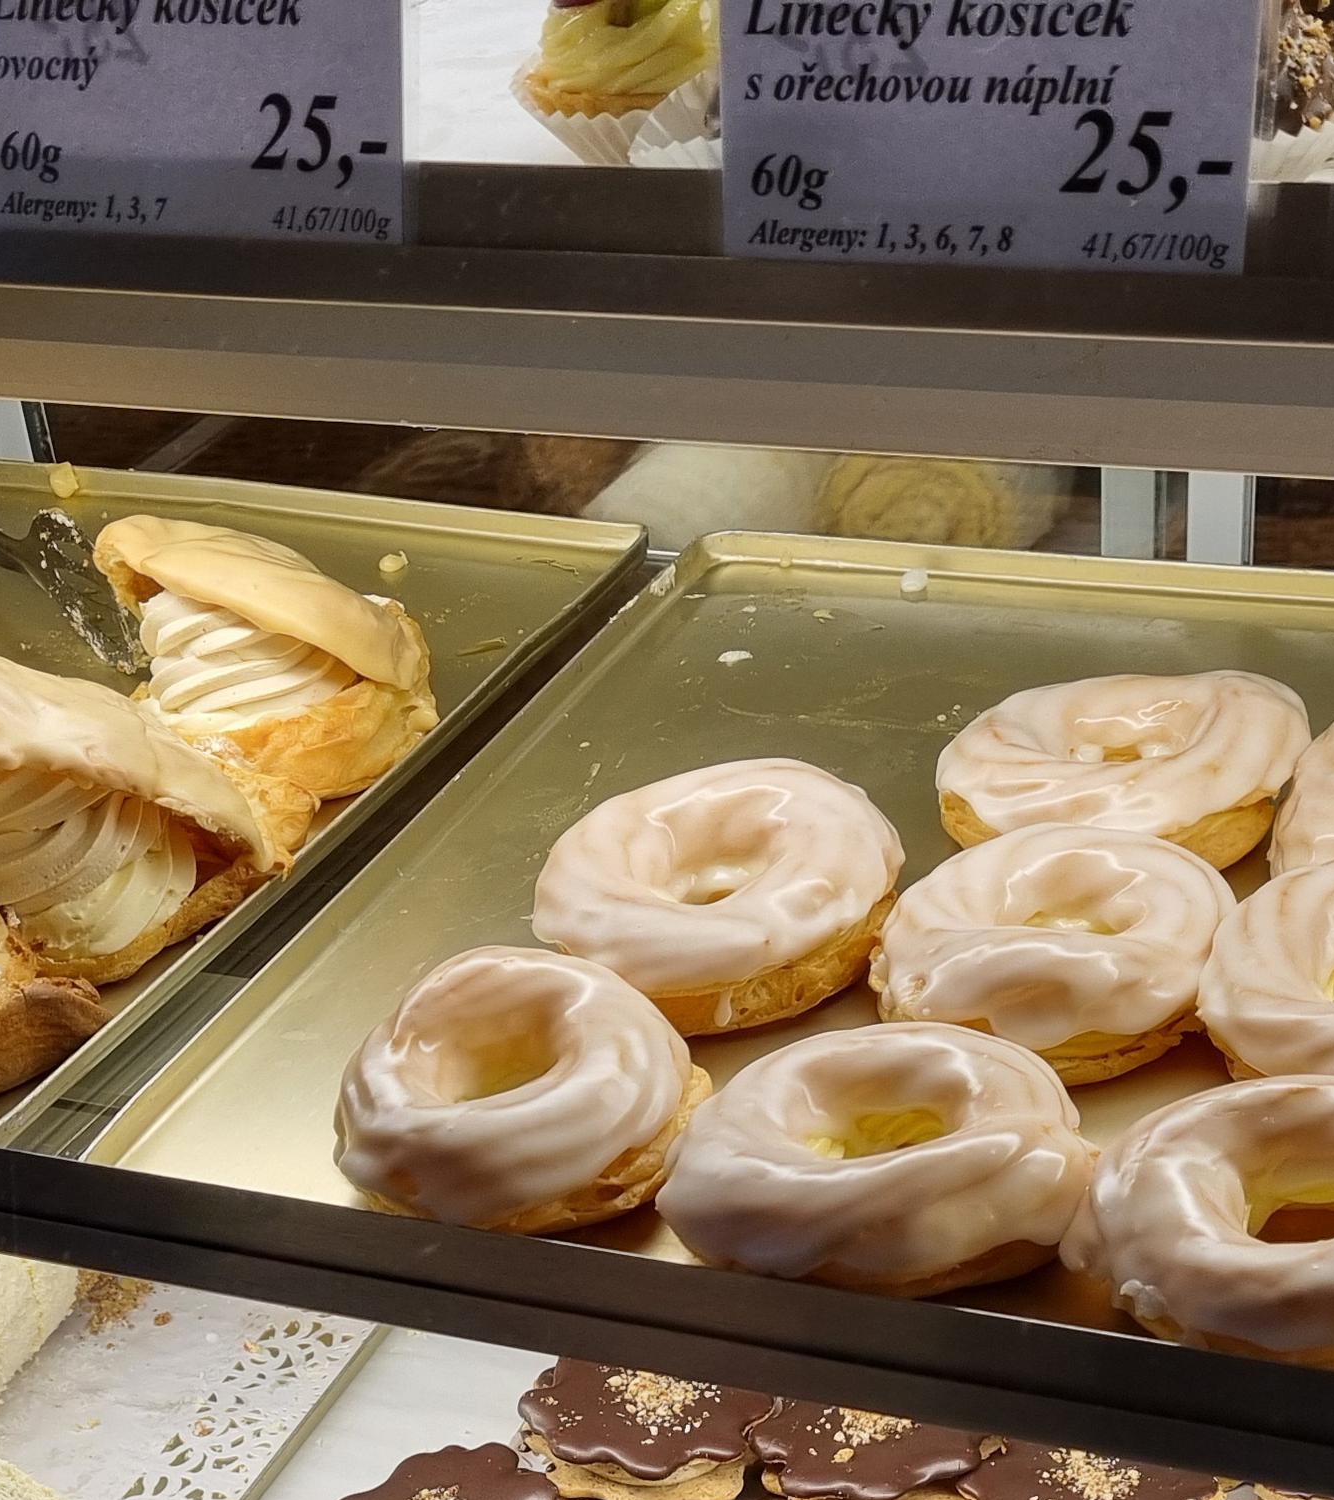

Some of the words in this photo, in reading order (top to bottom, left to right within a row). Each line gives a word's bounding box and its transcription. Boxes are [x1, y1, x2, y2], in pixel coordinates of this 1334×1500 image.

[744, 71, 763, 102] s
[773, 63, 971, 105] ořechovou
[982, 64, 1122, 117] náplní
[0, 130, 62, 183] 60g
[251, 92, 388, 189] 25,-
[1059, 108, 1233, 214] 25,-
[0, 191, 98, 222] Alergeny:
[104, 194, 119, 222] 1,
[126, 196, 149, 223] 3,
[154, 198, 167, 221] 7
[751, 153, 830, 210] 60g
[271, 205, 392, 241] 41,67/100g
[747, 219, 868, 254] Alergeny:
[875, 222, 896, 256] 1,
[904, 224, 927, 256] 3,
[935, 224, 958, 256] 6,
[969, 225, 989, 257] 7,
[997, 225, 1014, 252] 8
[1080, 232, 1230, 269] 41,67/100g
